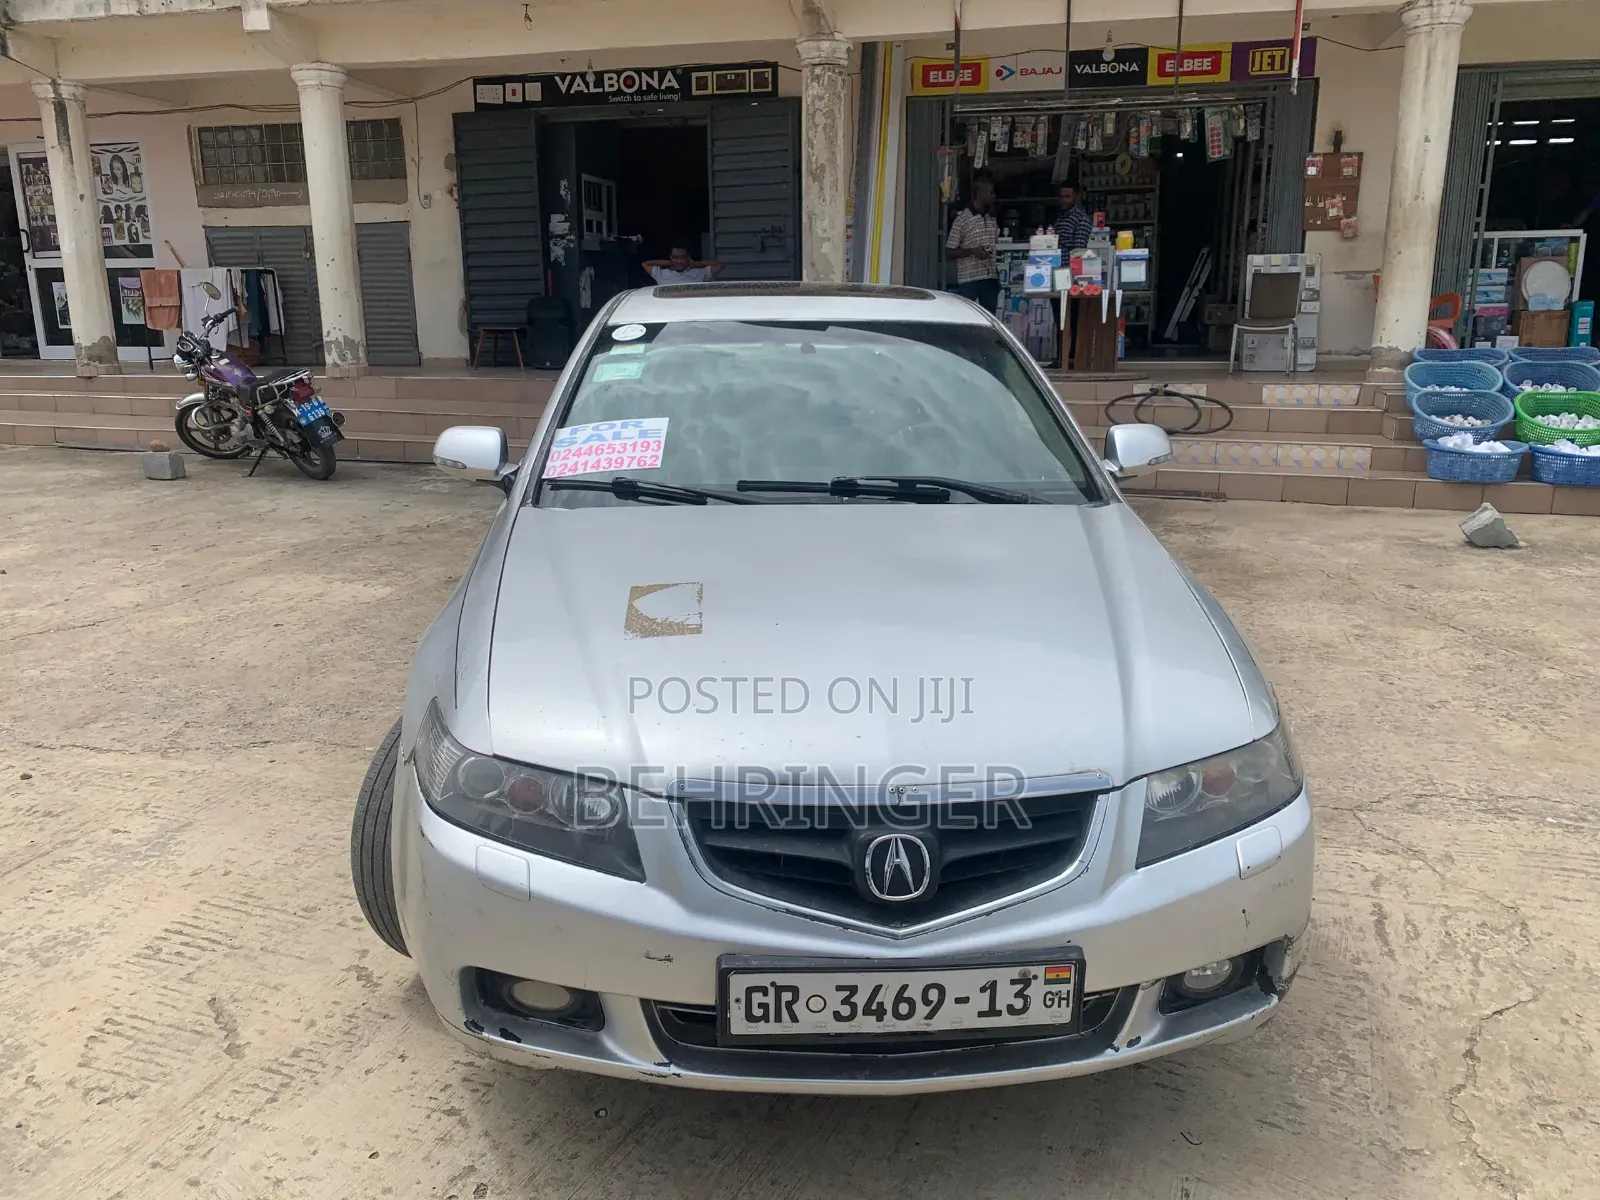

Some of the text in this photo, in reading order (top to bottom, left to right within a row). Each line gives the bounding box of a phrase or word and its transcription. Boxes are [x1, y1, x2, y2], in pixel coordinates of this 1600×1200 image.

[1020, 67, 1062, 76] BAJAJ
[1075, 62, 1140, 74] VALBONA
[1252, 50, 1286, 72] JET
[554, 70, 680, 95] VALBONA
[608, 95, 633, 103] Switch
[642, 93, 658, 101] safe
[659, 91, 681, 101] living!
[554, 428, 663, 449] SALE
[570, 420, 644, 436] FOR
[550, 439, 662, 462] 0244653193
[545, 454, 660, 477] 0241439762
[744, 976, 1071, 1024] GR 3469-13 GH
